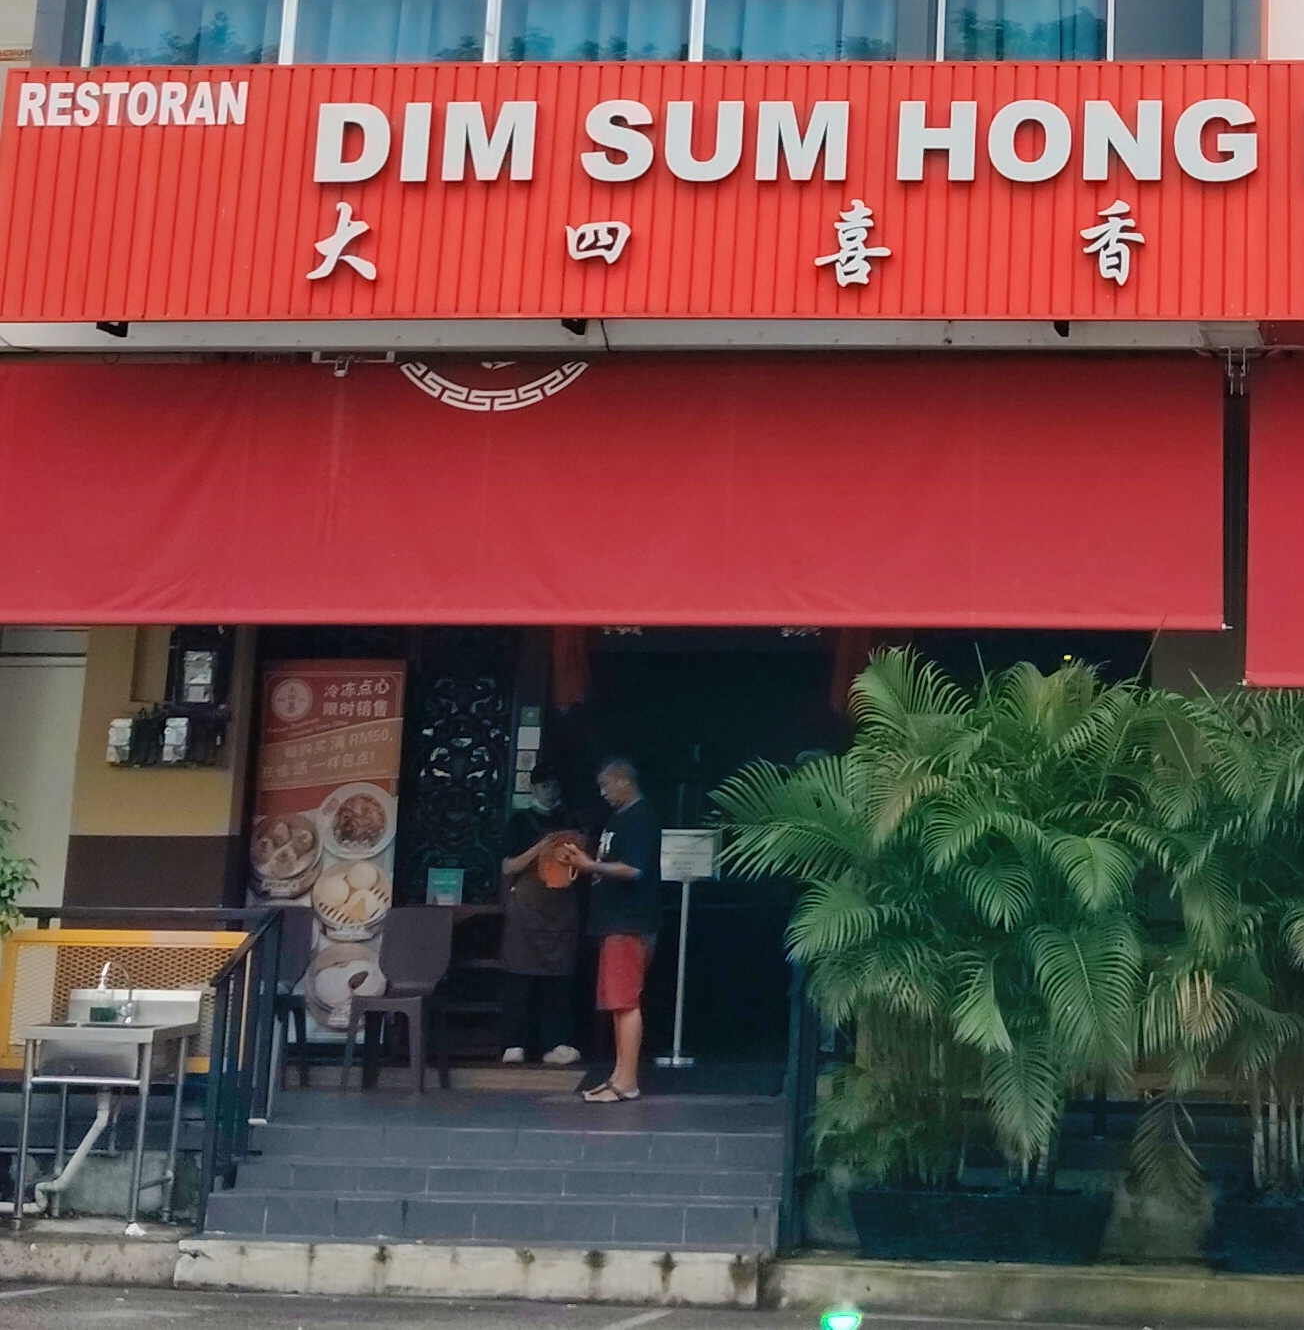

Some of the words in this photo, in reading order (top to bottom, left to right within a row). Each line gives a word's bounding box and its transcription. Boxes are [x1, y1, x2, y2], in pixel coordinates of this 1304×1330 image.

[16, 80, 250, 128] RESTORAN
[313, 100, 538, 183] DIM
[579, 99, 850, 184] SUM
[896, 98, 1259, 183] HONG
